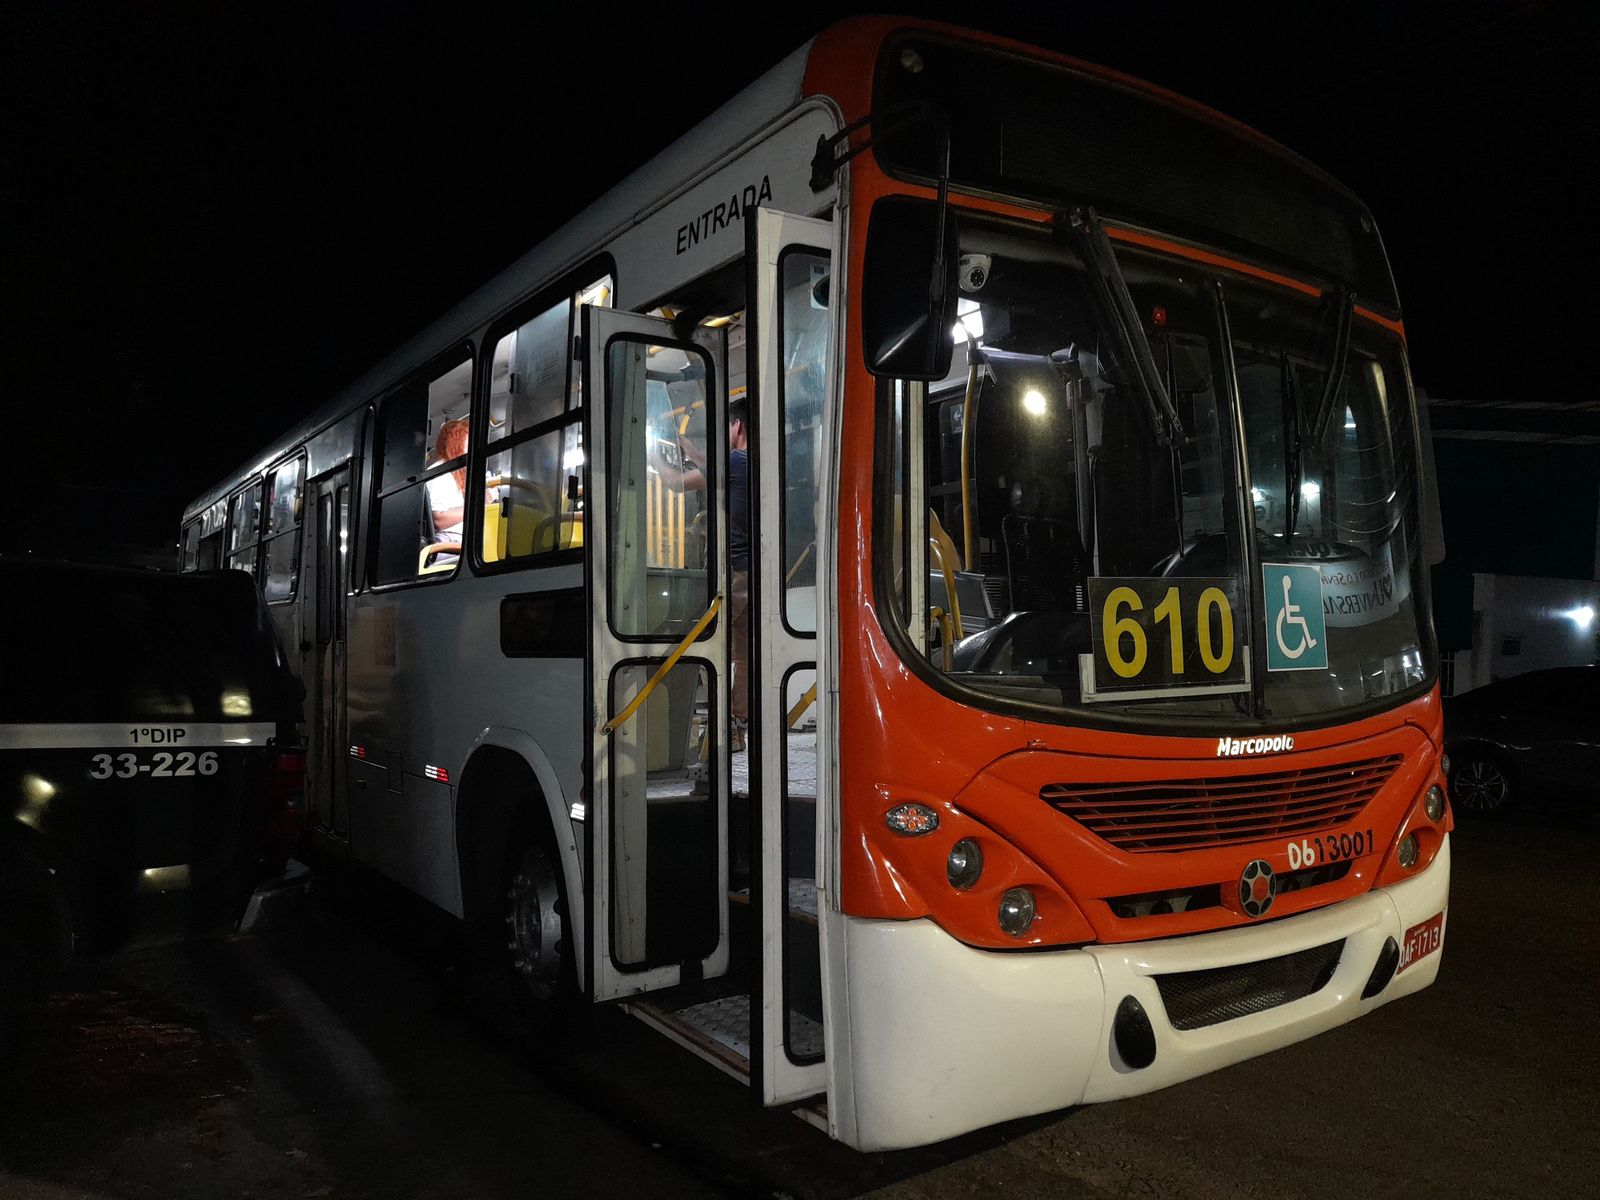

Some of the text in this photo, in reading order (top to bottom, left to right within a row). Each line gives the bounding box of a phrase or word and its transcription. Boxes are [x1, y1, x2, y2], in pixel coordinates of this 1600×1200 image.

[676, 175, 772, 255] ENTRADA
[1102, 586, 1235, 679] 610
[90, 751, 219, 780] 33-226
[1217, 734, 1295, 758] Marcopolo
